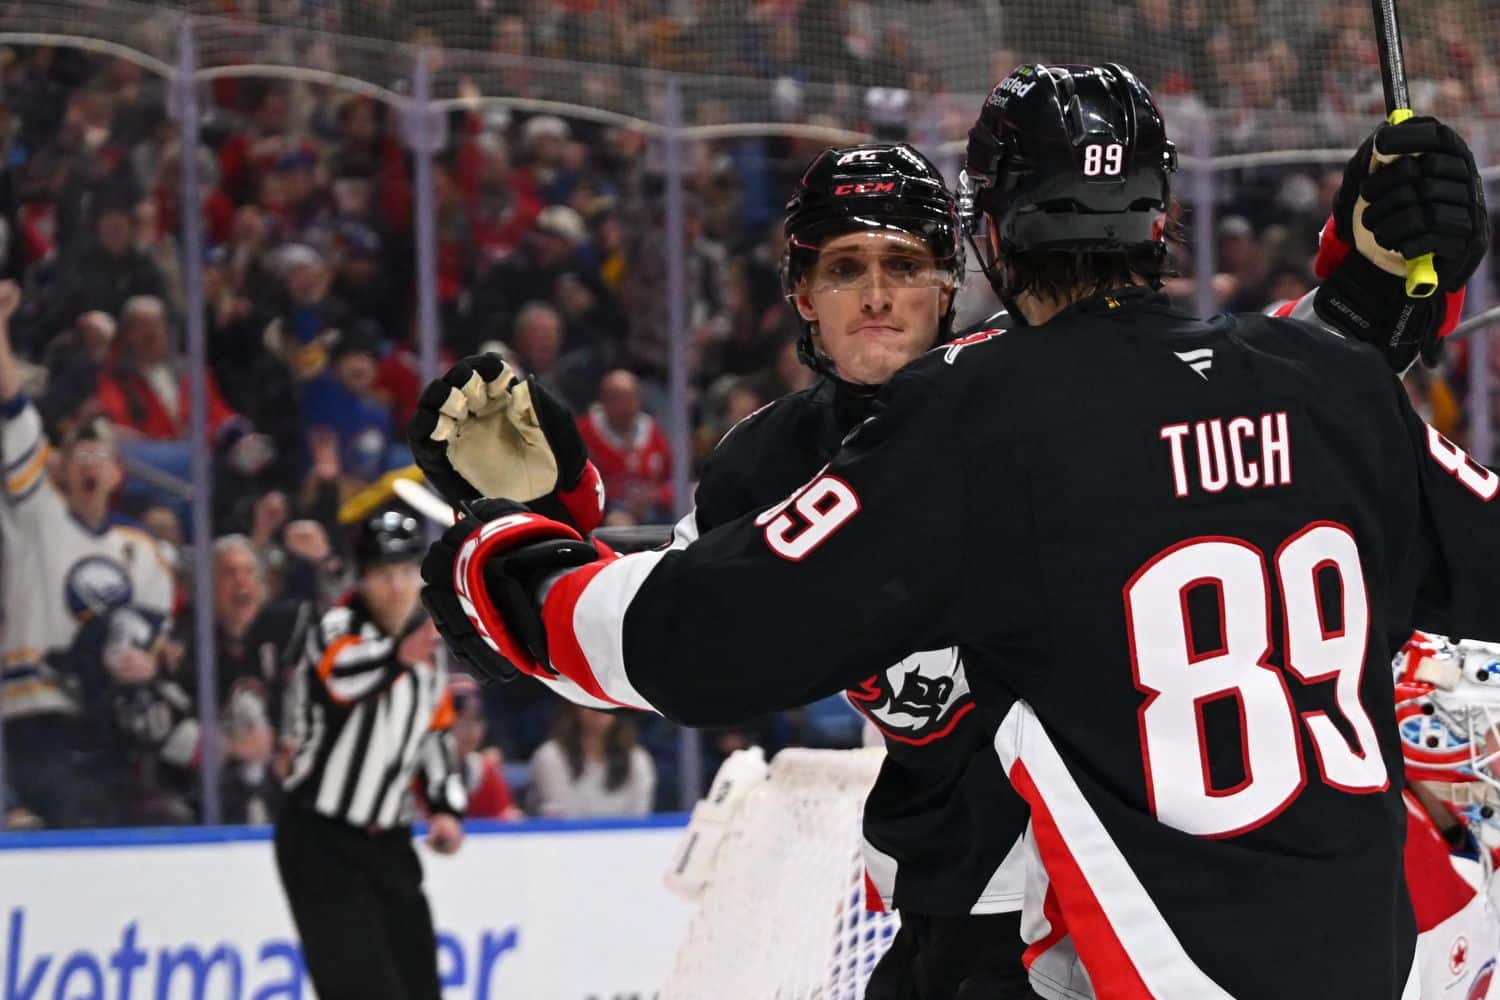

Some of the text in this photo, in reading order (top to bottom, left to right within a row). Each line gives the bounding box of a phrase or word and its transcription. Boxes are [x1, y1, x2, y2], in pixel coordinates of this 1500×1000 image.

[833, 181, 896, 196] CCM
[1084, 143, 1123, 176] 89
[1160, 411, 1292, 498] TUCH
[753, 462, 862, 562] 9
[1122, 520, 1390, 840] 89
